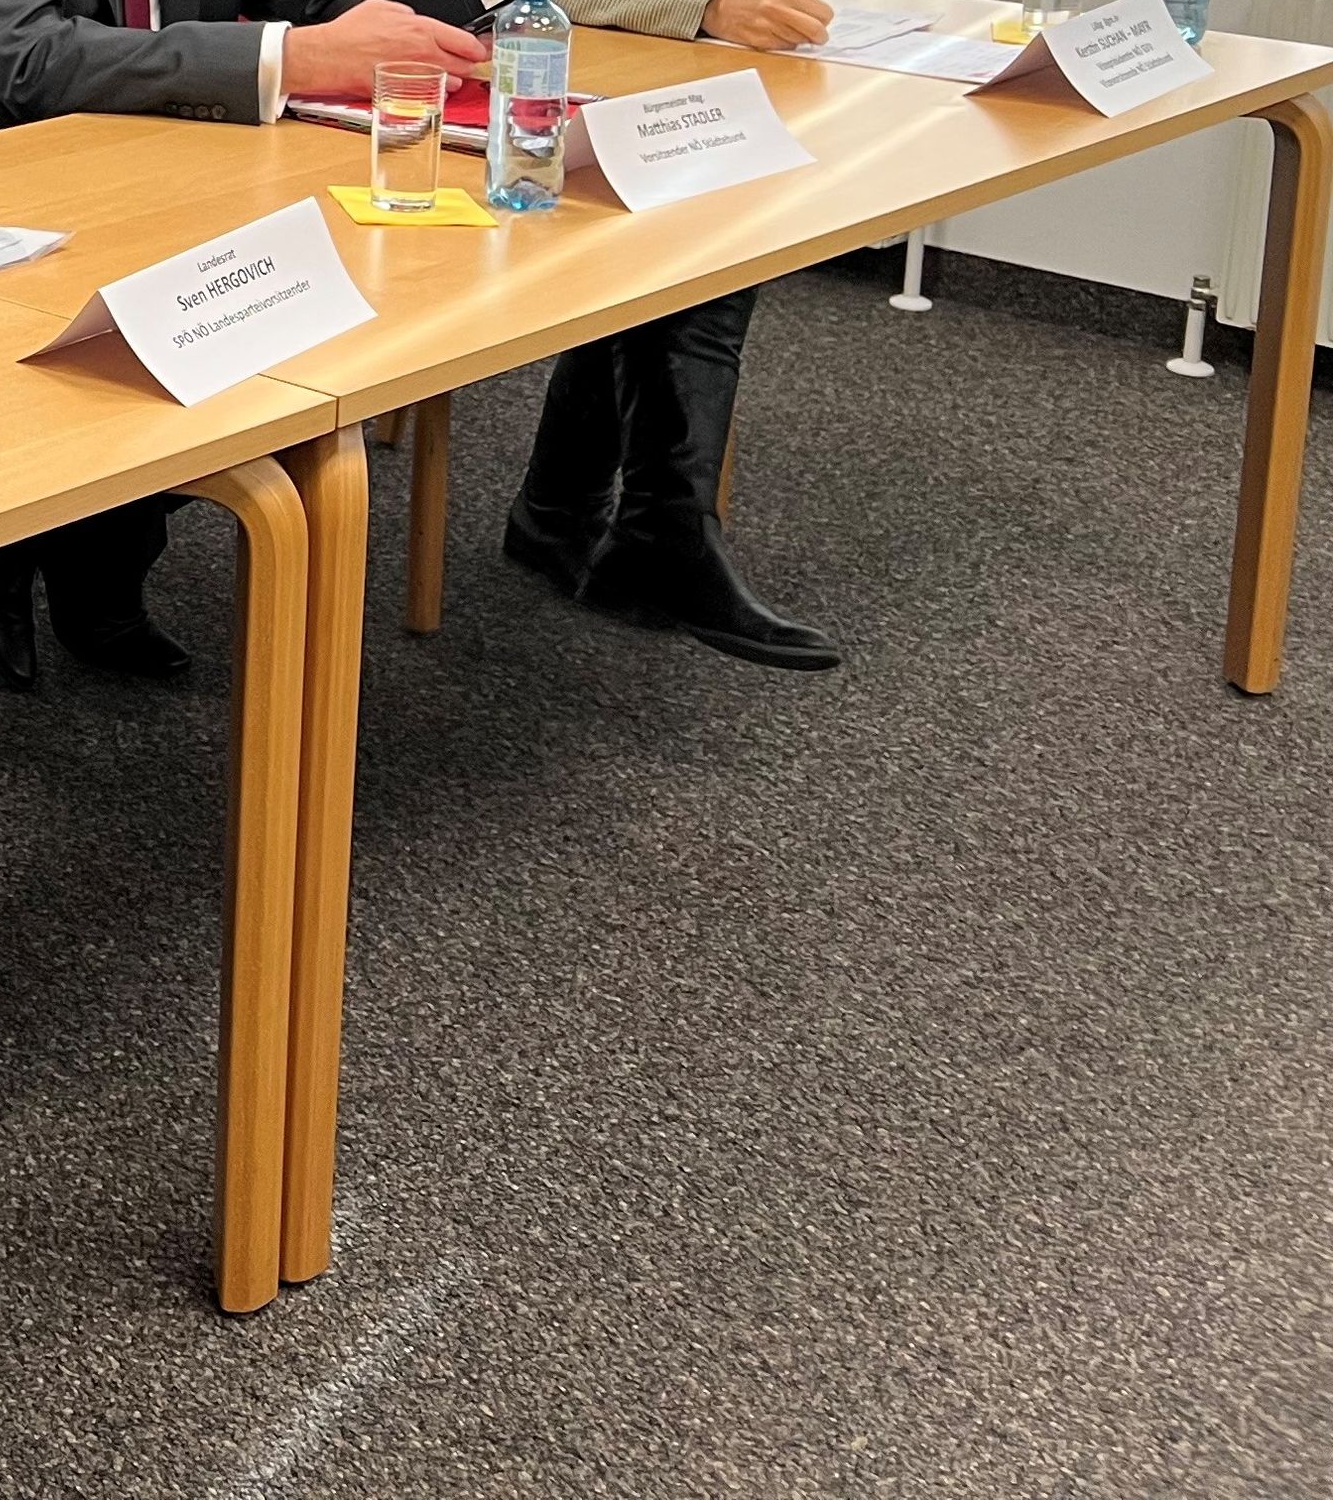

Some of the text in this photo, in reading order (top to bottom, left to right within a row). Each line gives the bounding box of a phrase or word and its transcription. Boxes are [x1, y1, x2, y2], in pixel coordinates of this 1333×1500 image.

[637, 108, 725, 138] Matthias STADLER
[197, 249, 237, 273] Landesrat
[177, 256, 276, 312] Sven HERGOVICH
[172, 279, 311, 349] SPÖ NÖ Landesparteivorsitzender
